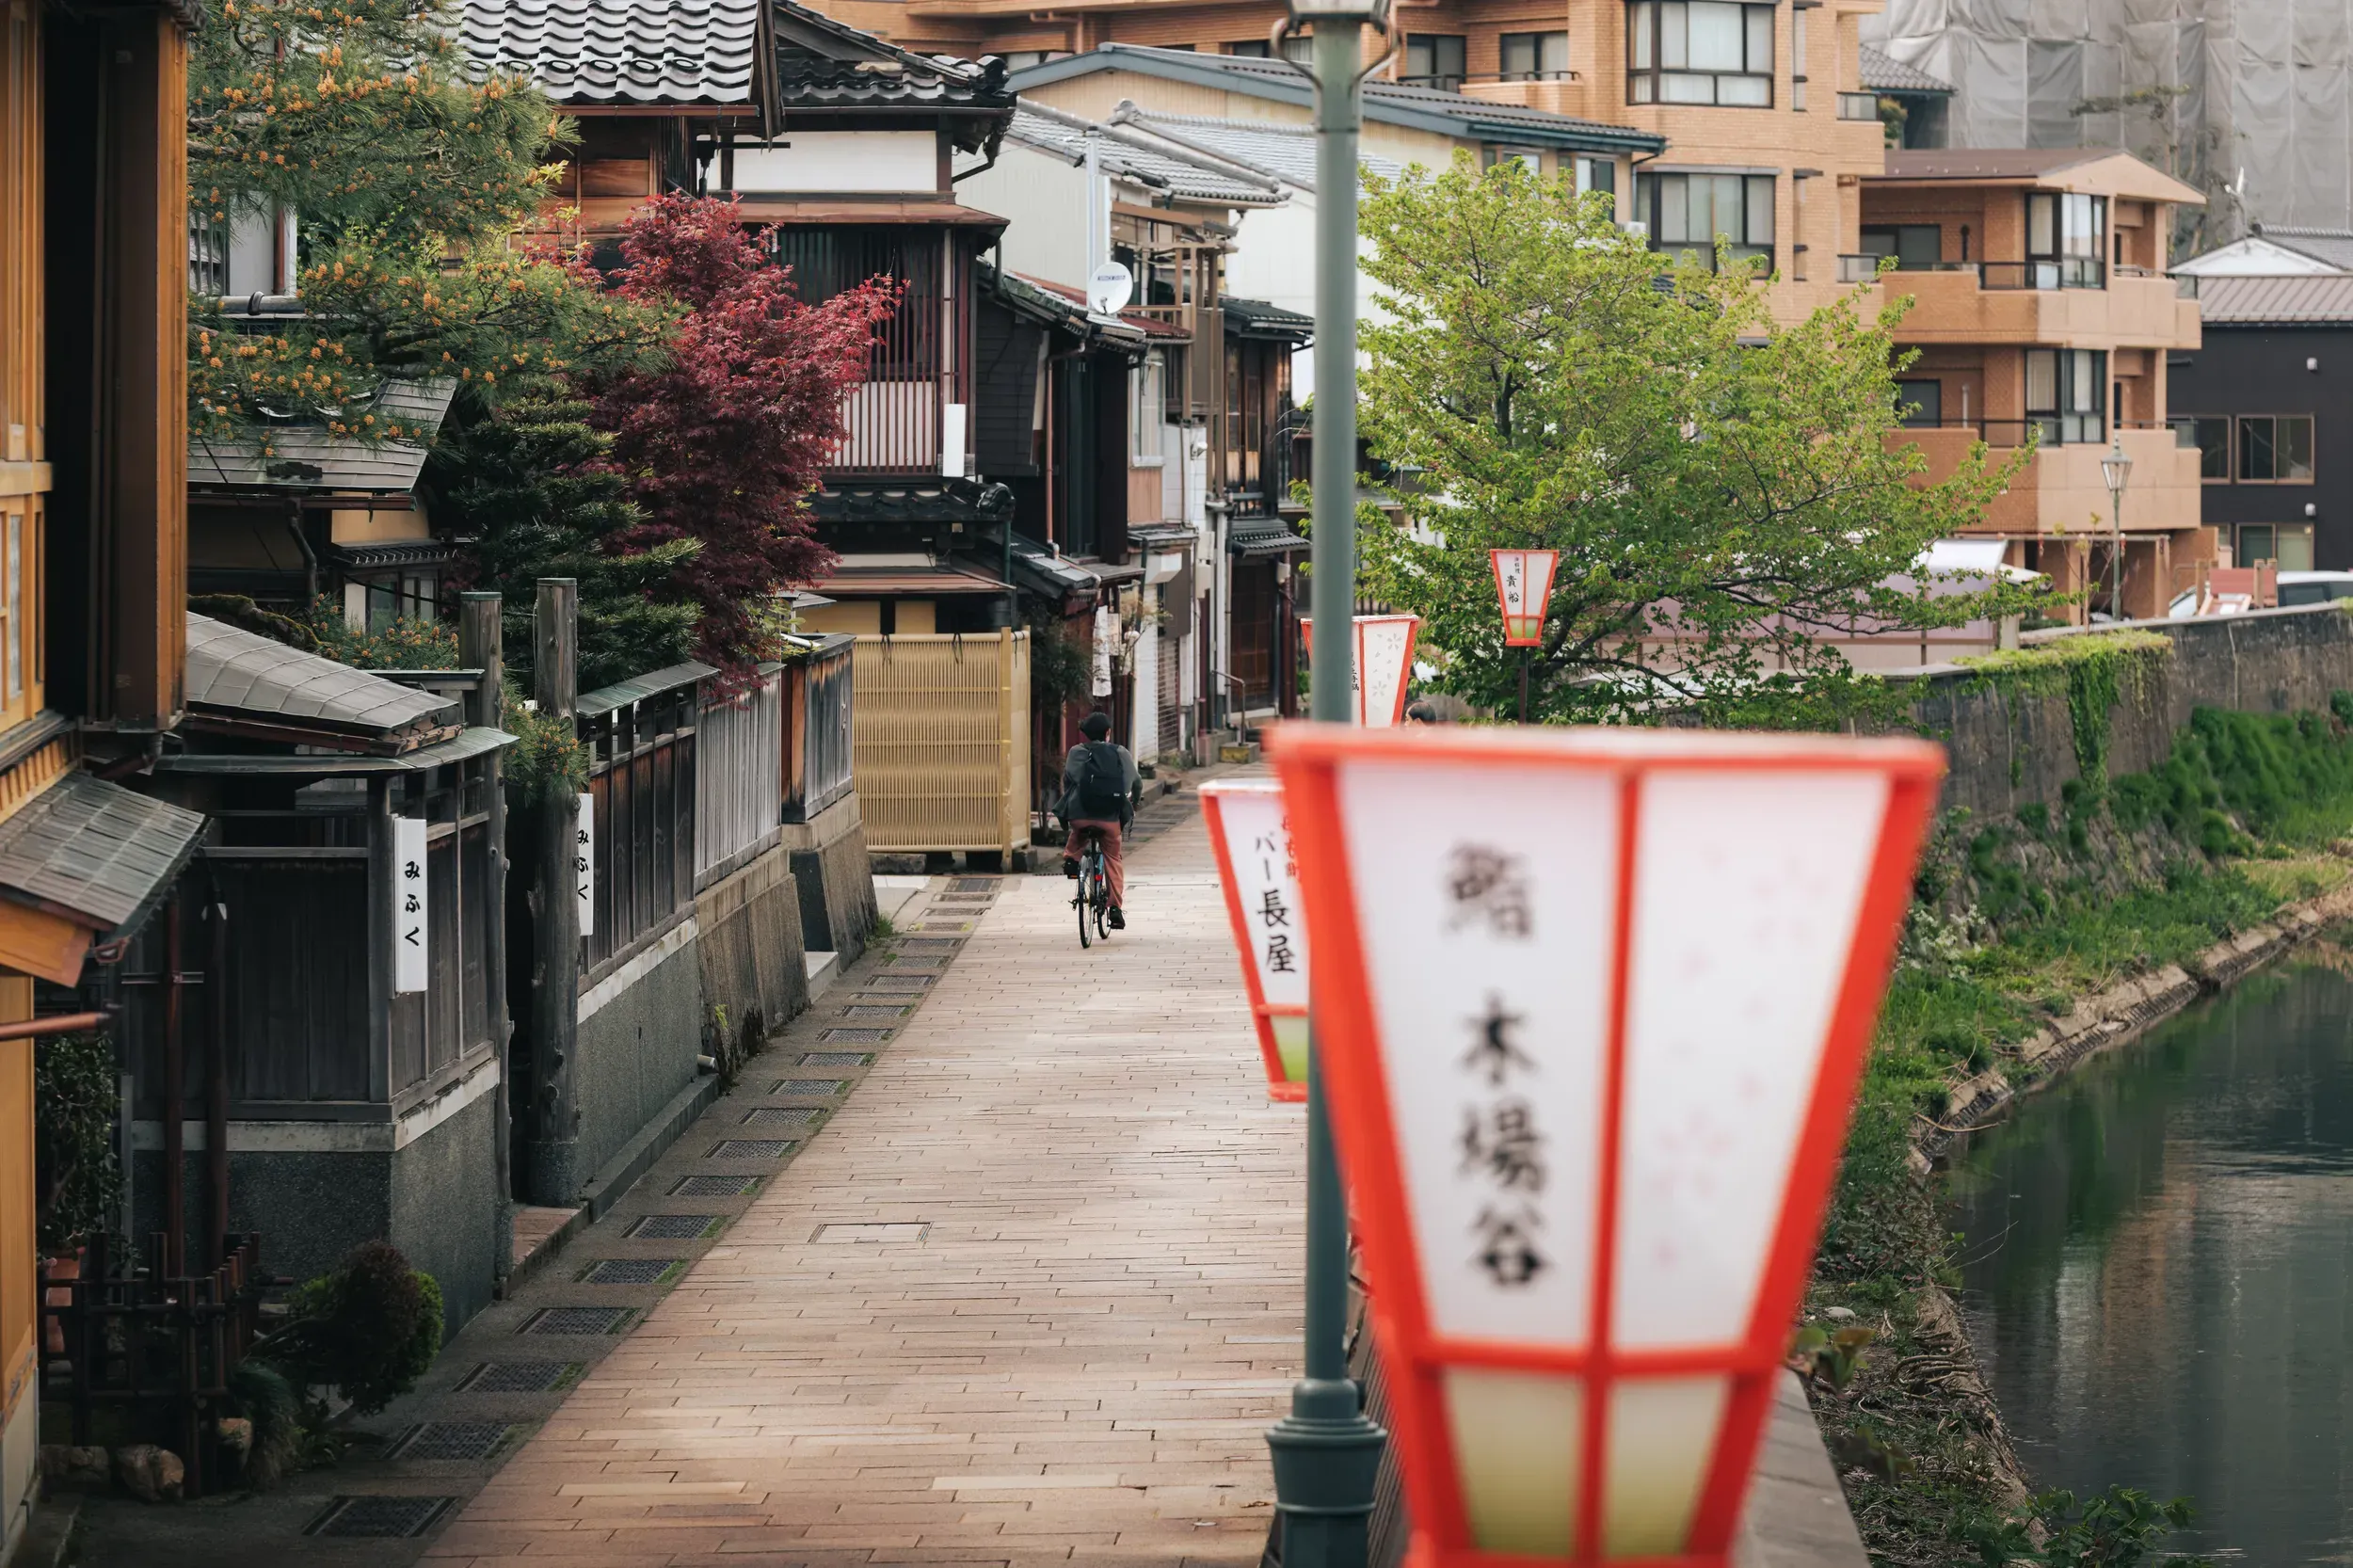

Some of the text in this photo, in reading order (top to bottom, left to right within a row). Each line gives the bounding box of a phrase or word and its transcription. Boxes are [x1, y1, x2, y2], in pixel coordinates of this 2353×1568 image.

[404, 860, 421, 947] みふく
[578, 829, 589, 901] みふく
[1256, 830, 1296, 974] バー長屋
